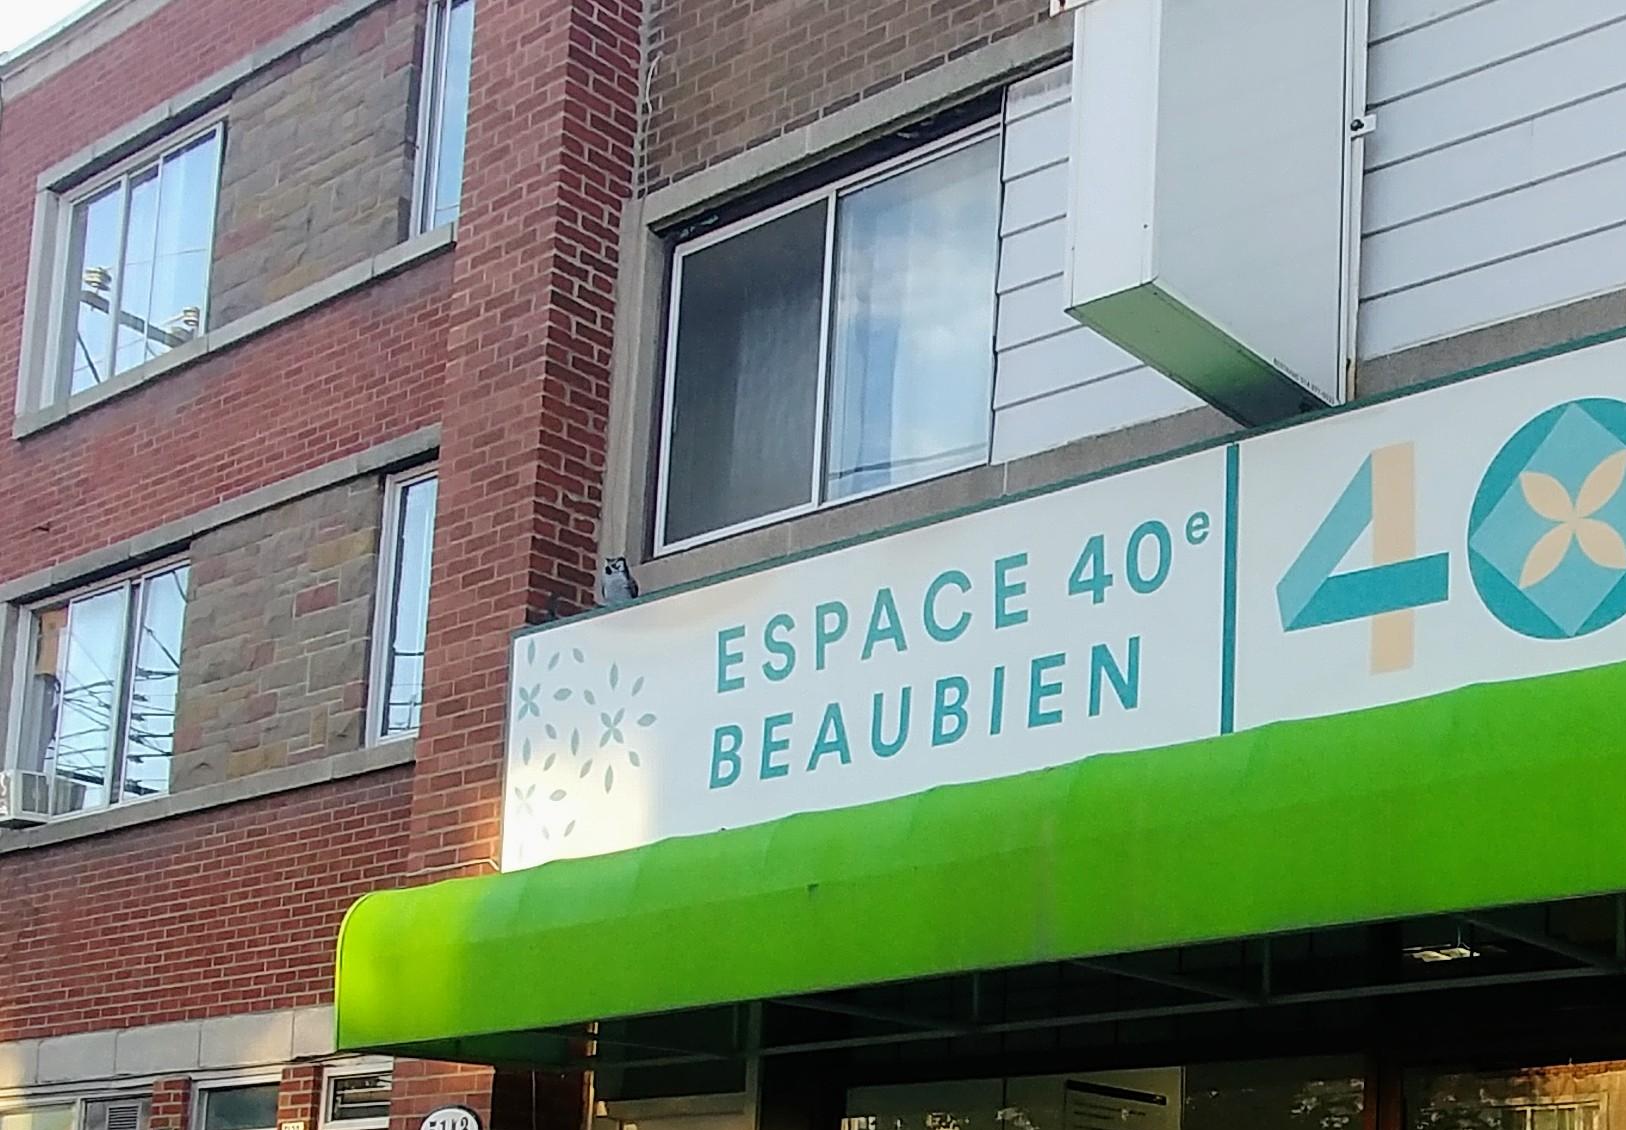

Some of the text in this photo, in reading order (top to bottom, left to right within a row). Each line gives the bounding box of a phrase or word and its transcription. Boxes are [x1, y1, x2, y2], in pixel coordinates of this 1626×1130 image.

[716, 510, 1211, 694] ESPACE 40e
[708, 636, 1141, 790] BEAUBIEN
